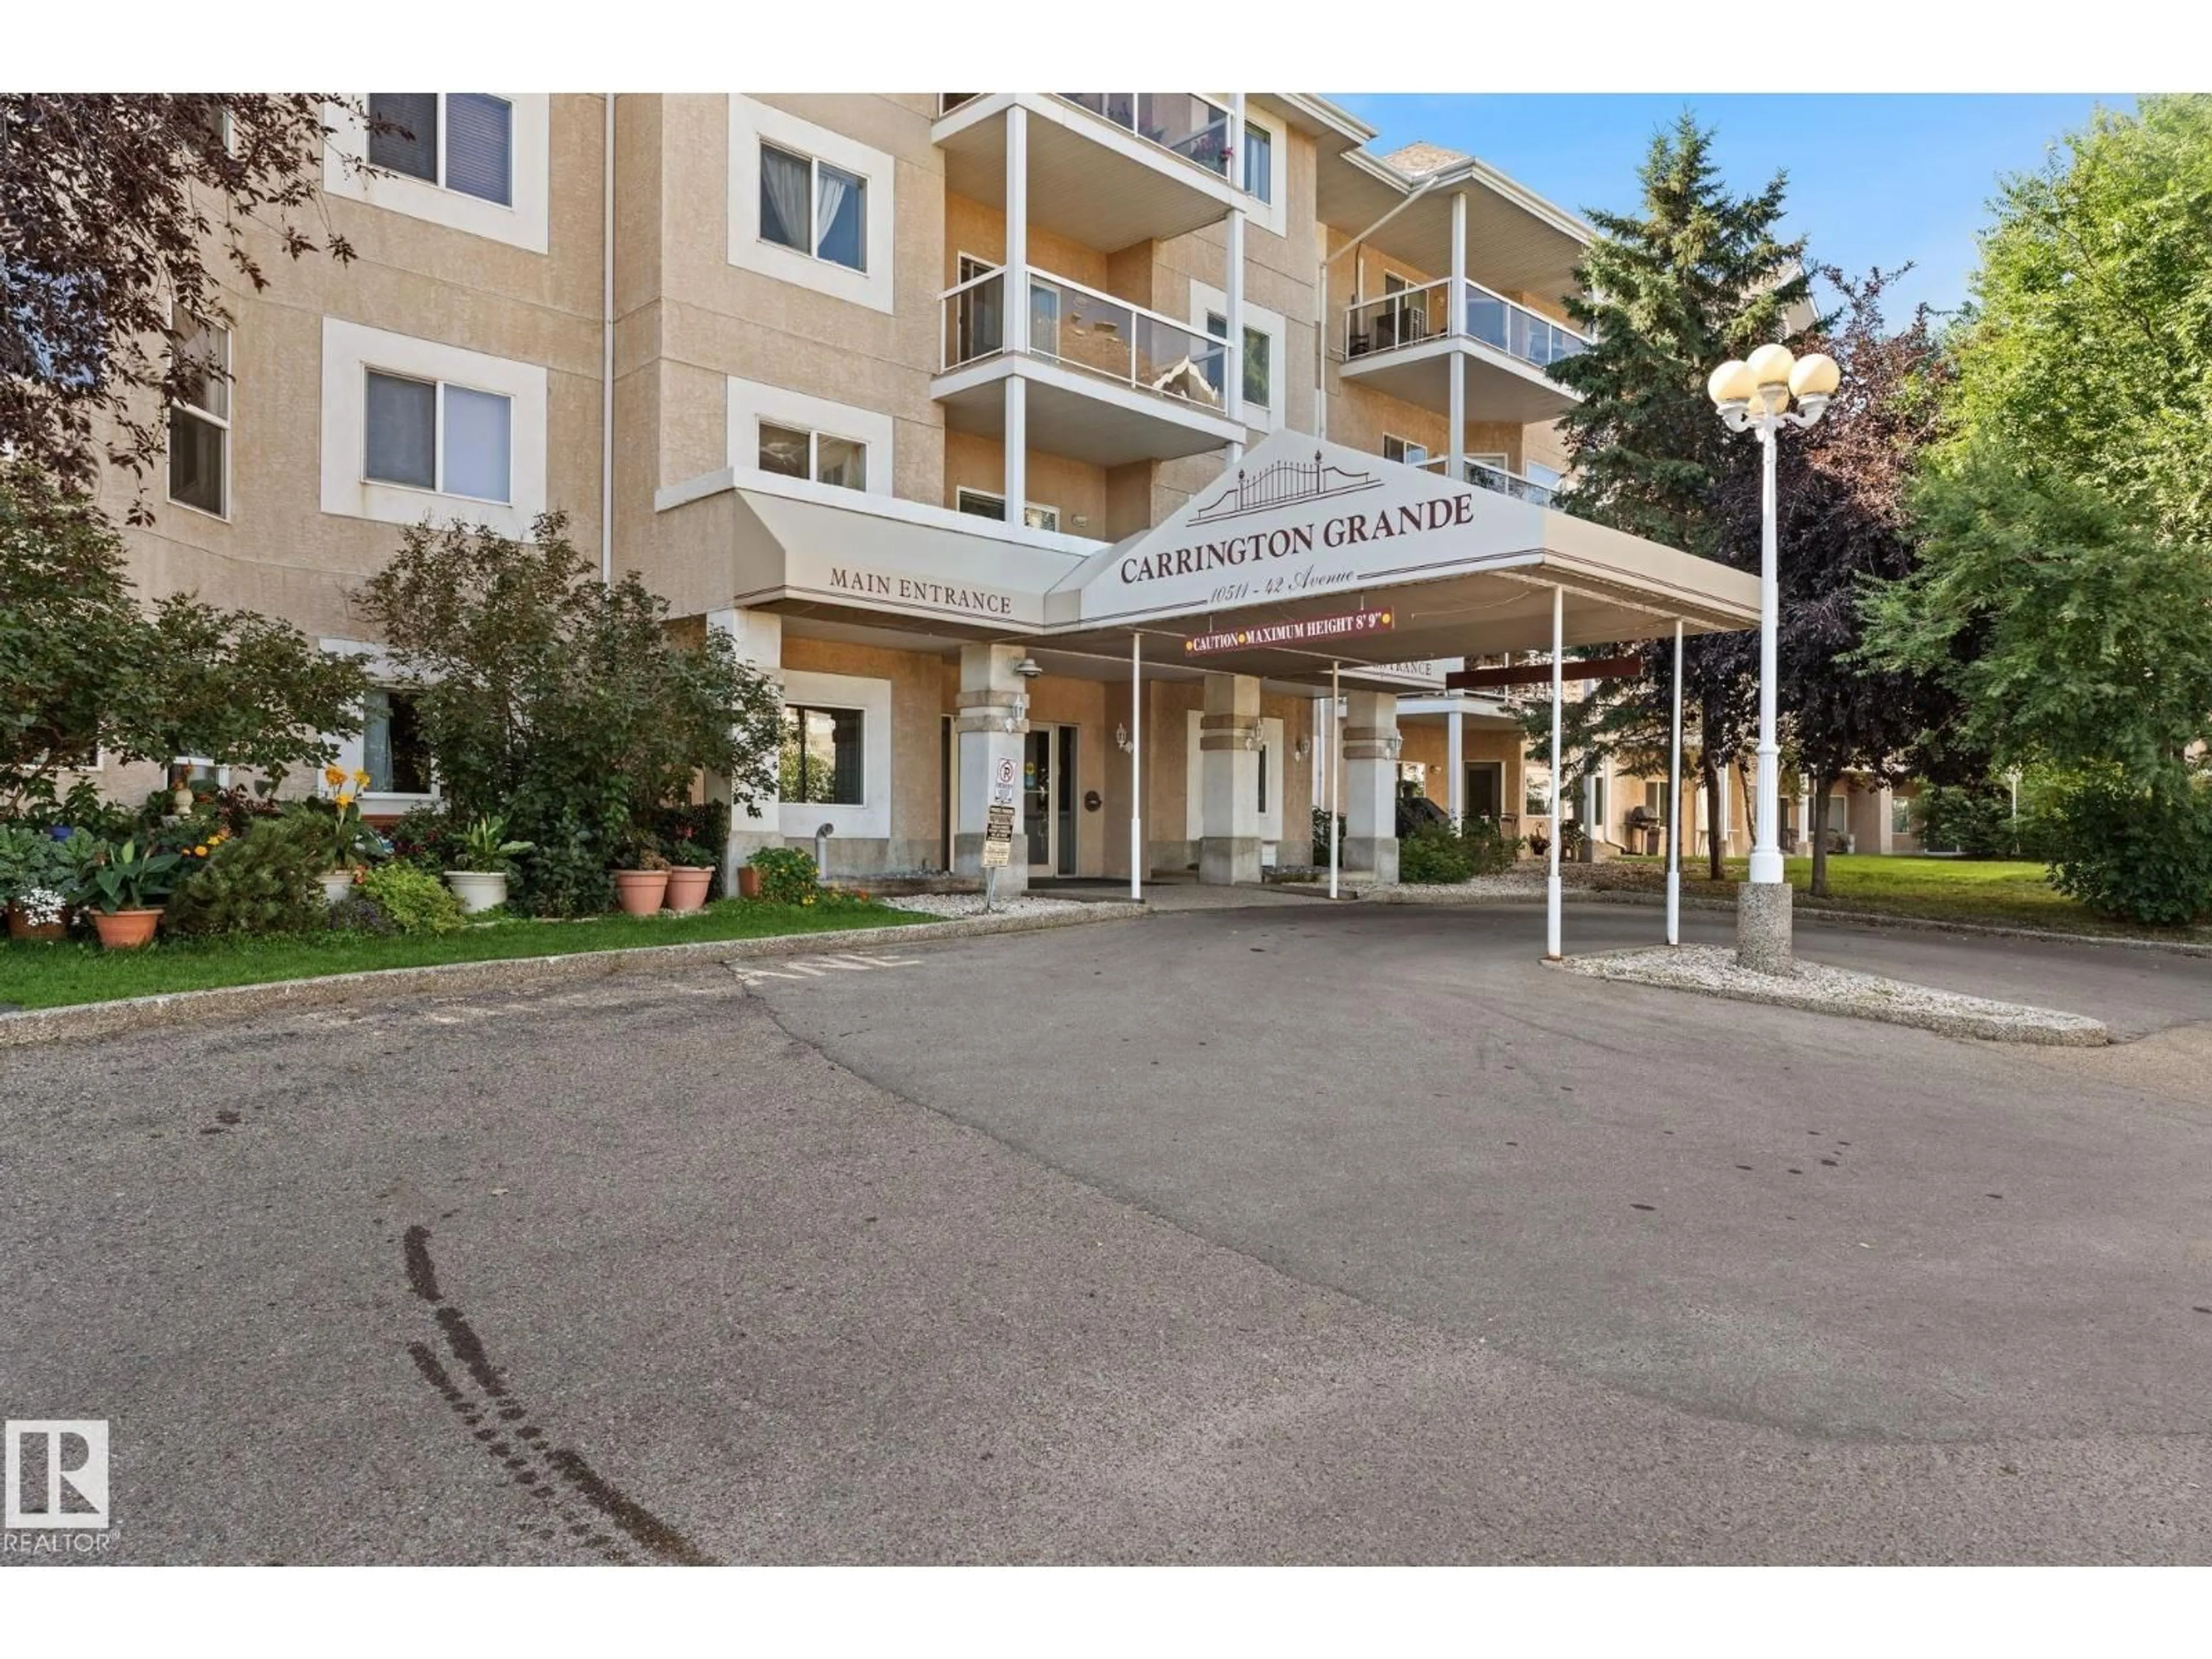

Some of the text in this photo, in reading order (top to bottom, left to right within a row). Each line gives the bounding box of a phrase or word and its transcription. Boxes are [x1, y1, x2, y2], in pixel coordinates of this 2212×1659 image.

[1121, 493, 1474, 584] CARRINGTON GRANDE
[830, 567, 1012, 613] MAIN ENTRANCE
[1210, 581, 1249, 604] 10511
[1265, 577, 1284, 594] 42
[1288, 565, 1355, 590] Avenue
[1192, 633, 1238, 652] CAUTION
[1245, 624, 1304, 645] MAXIMUM
[1307, 616, 1353, 636] HEIGHT
